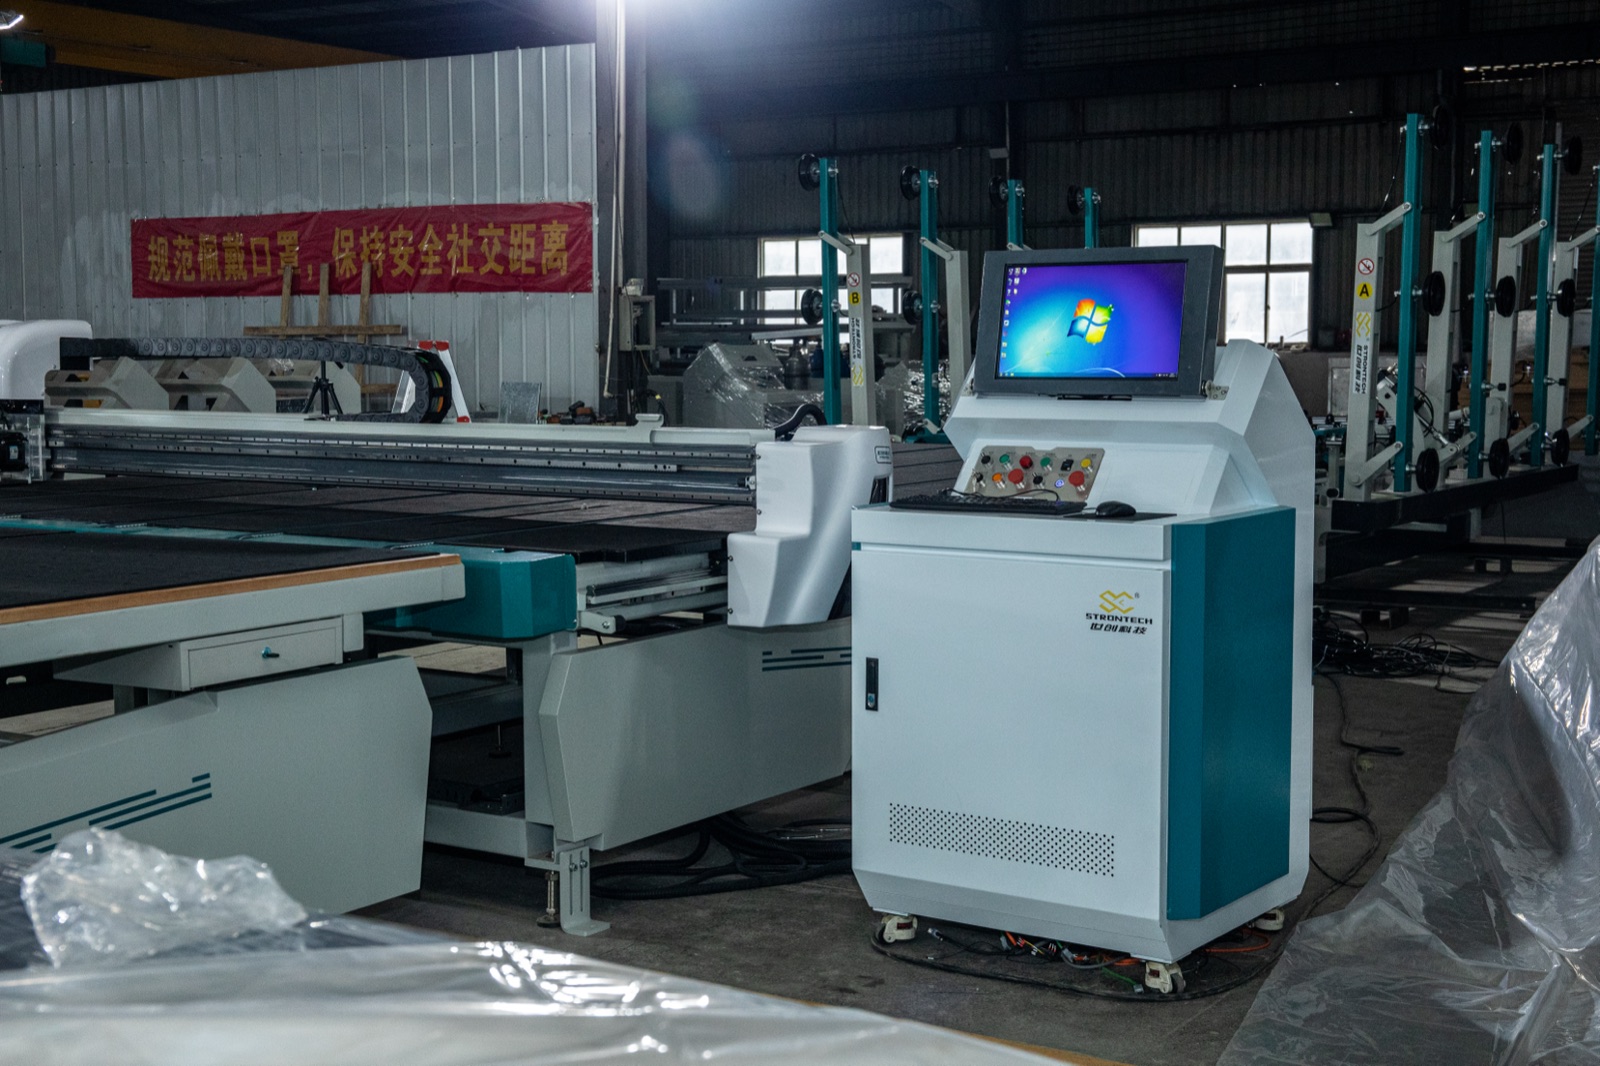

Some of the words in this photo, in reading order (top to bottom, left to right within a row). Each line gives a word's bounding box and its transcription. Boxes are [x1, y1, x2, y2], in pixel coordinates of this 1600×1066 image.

[1359, 284, 1369, 297] A
[852, 292, 859, 304] B
[1086, 613, 1153, 624] STRONTECH
